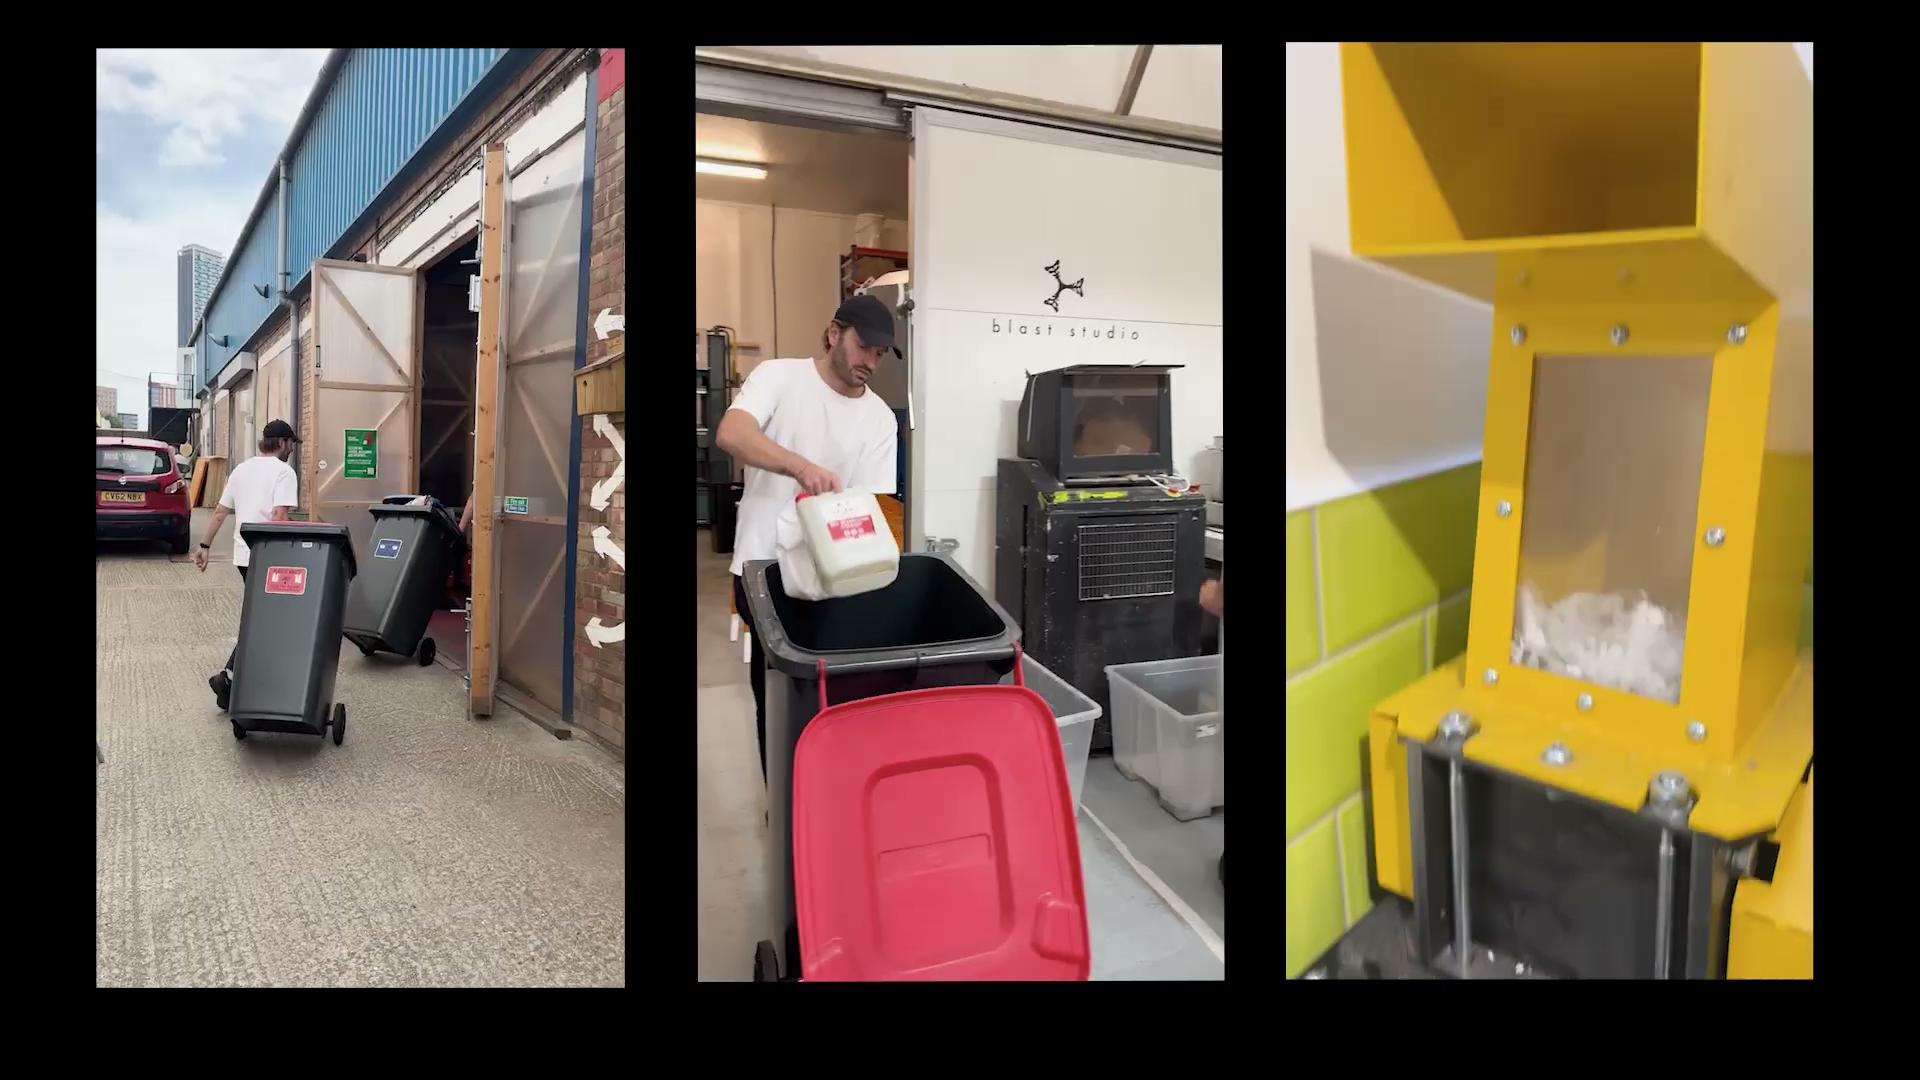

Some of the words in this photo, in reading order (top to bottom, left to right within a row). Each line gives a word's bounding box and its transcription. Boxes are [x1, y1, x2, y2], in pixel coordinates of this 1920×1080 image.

[992, 318, 1053, 335] blast
[1069, 324, 1140, 340] studio
[104, 492, 125, 501] CV62
[127, 493, 142, 502] NBX
